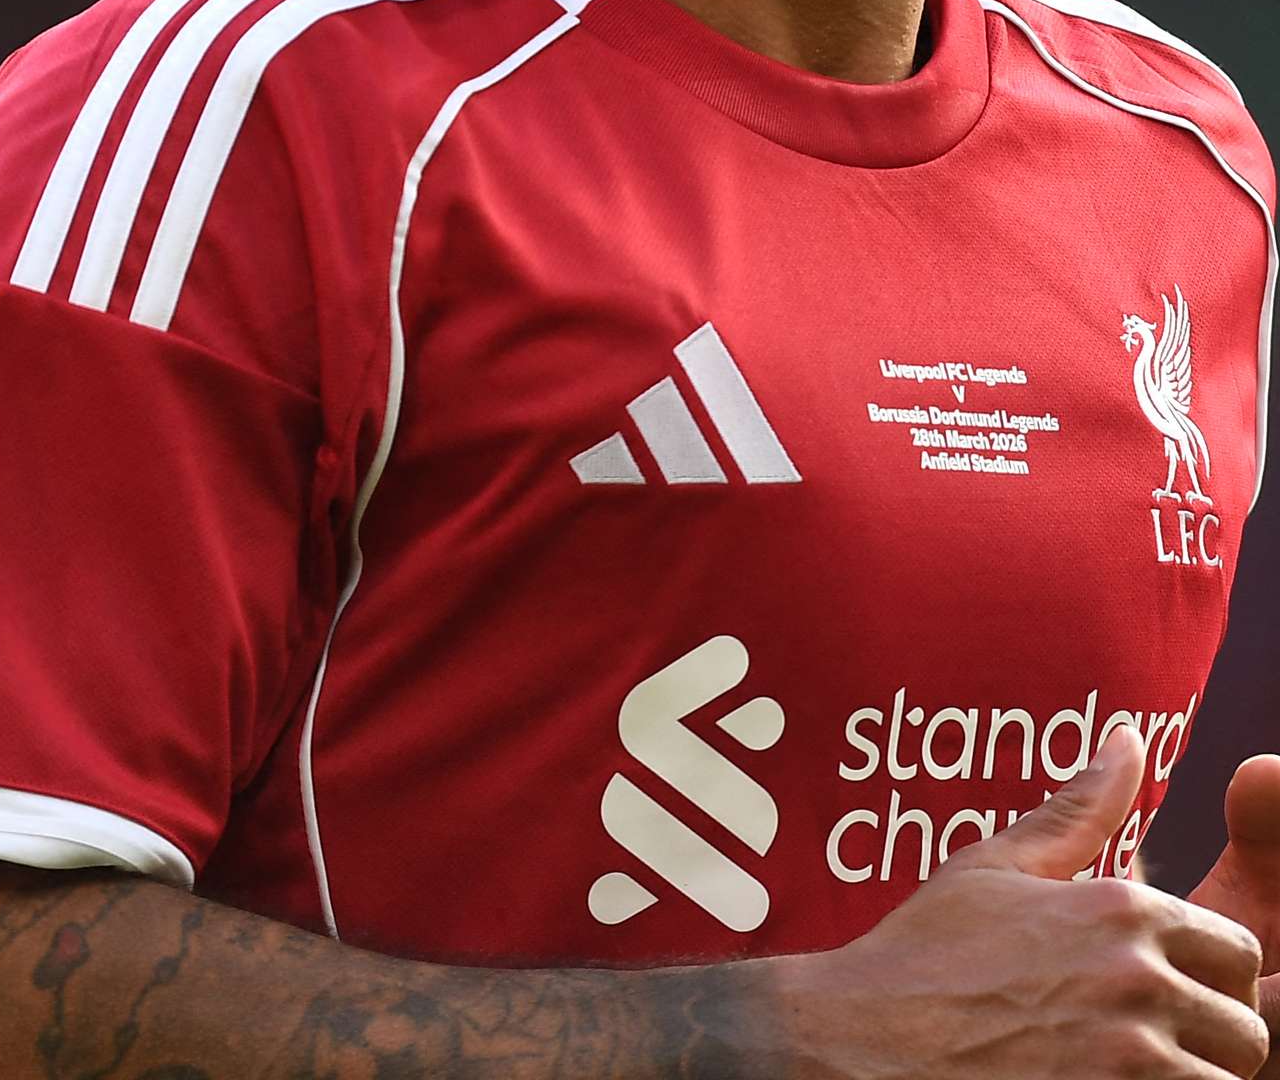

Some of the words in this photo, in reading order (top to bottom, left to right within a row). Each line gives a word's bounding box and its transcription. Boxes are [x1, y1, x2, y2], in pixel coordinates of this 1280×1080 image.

[879, 359, 947, 383] Liverpool
[945, 362, 968, 381] FC
[966, 364, 1027, 386] Legends
[867, 403, 929, 423] Borussia
[928, 406, 1001, 428] Dortmund
[1001, 410, 1060, 433] Legends
[910, 428, 946, 447] 28th
[945, 430, 990, 449] March
[989, 434, 1028, 452] 2026
[920, 451, 971, 471] Anfield
[970, 454, 1029, 474] Stadium
